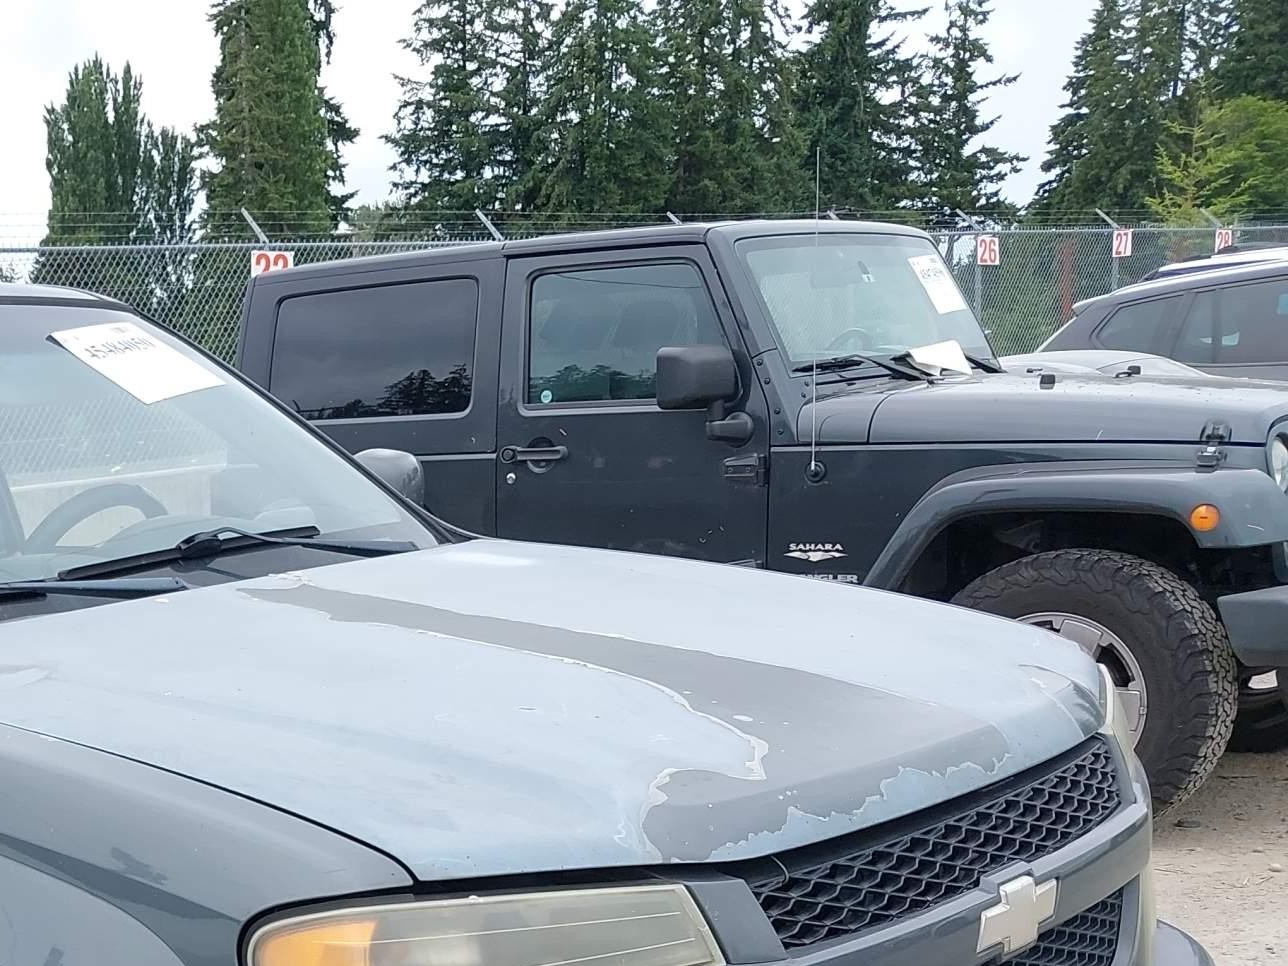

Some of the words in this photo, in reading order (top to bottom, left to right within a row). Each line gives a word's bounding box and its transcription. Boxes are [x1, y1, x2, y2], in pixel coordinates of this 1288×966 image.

[1115, 231, 1128, 256] 27
[1217, 231, 1230, 249] 28
[979, 239, 997, 263] 26
[789, 543, 843, 551] SAHARA
